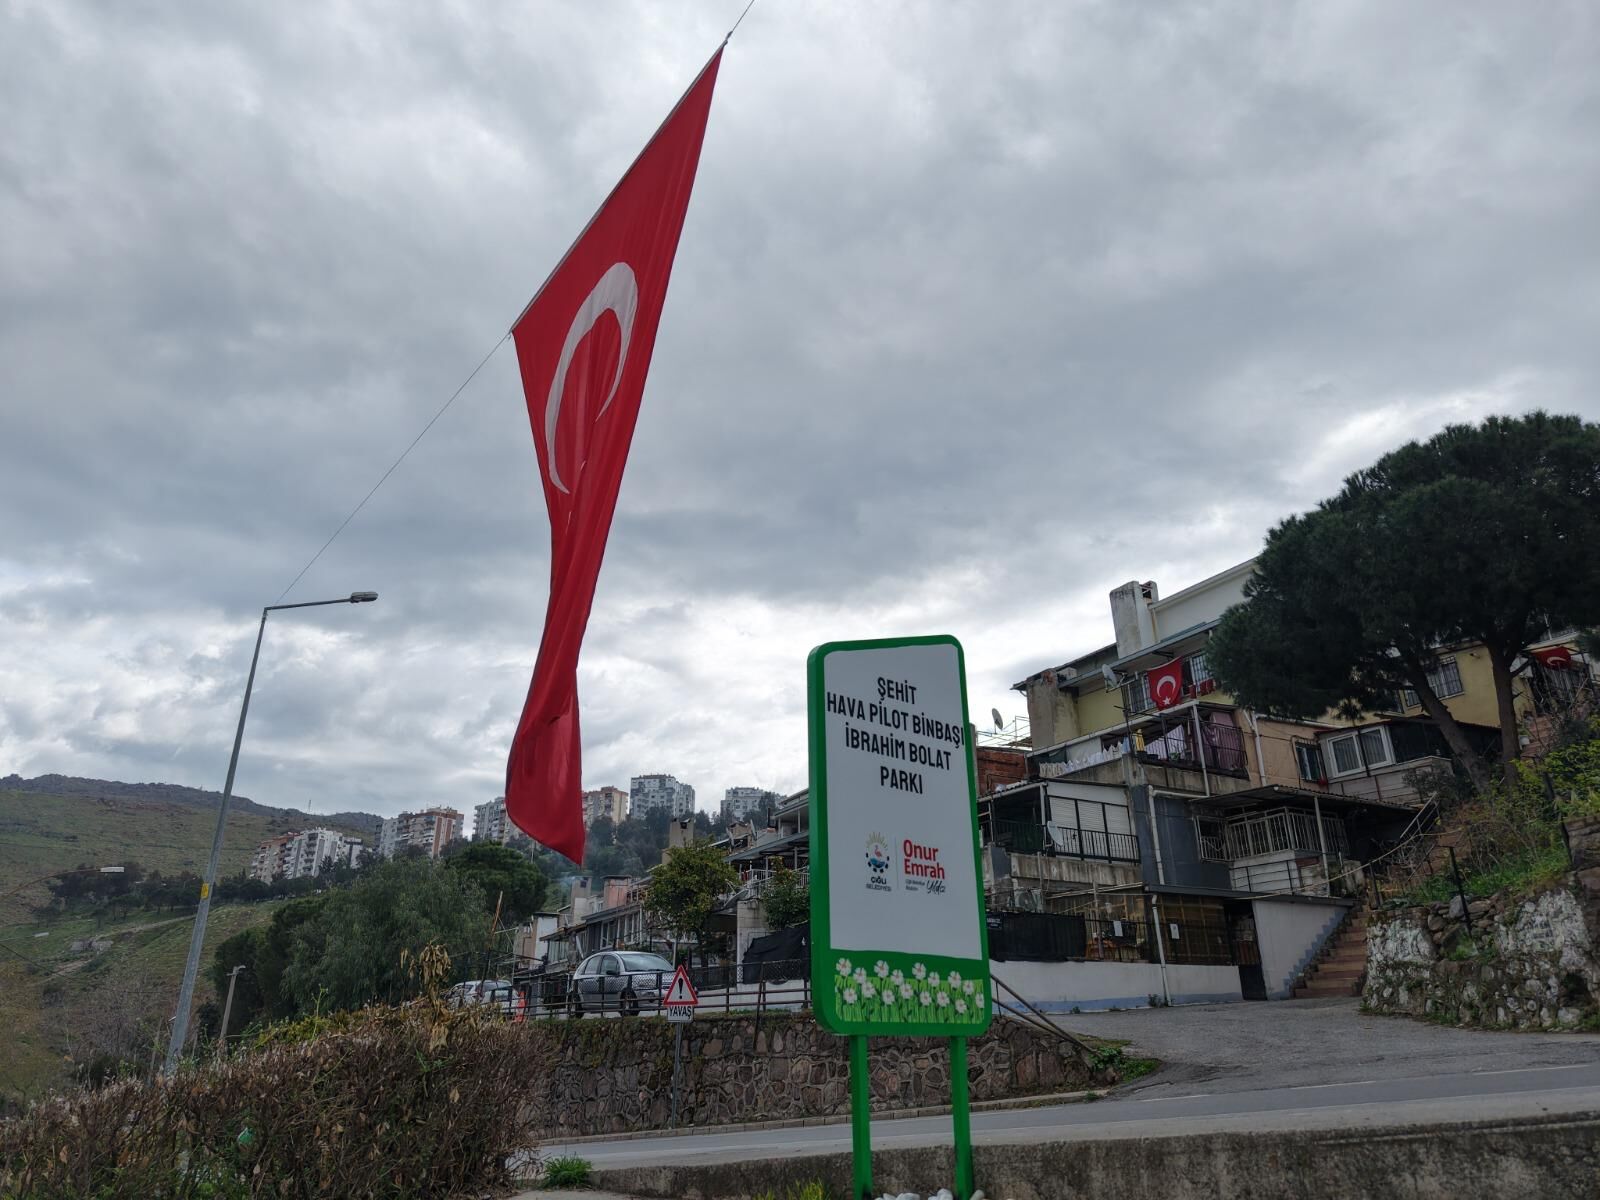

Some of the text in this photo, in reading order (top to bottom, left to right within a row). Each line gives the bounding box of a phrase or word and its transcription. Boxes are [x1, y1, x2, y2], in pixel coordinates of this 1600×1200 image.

[877, 676, 917, 704] ŞEHİT
[827, 691, 965, 748] HAVA PİLOT BİNBAŞI
[845, 721, 951, 770] İBRAHİM BOLAT
[880, 765, 923, 794] PARKI
[903, 839, 939, 861] Onur
[904, 858, 945, 880] Emrah
[669, 1005, 692, 1019] YAVAŞ
